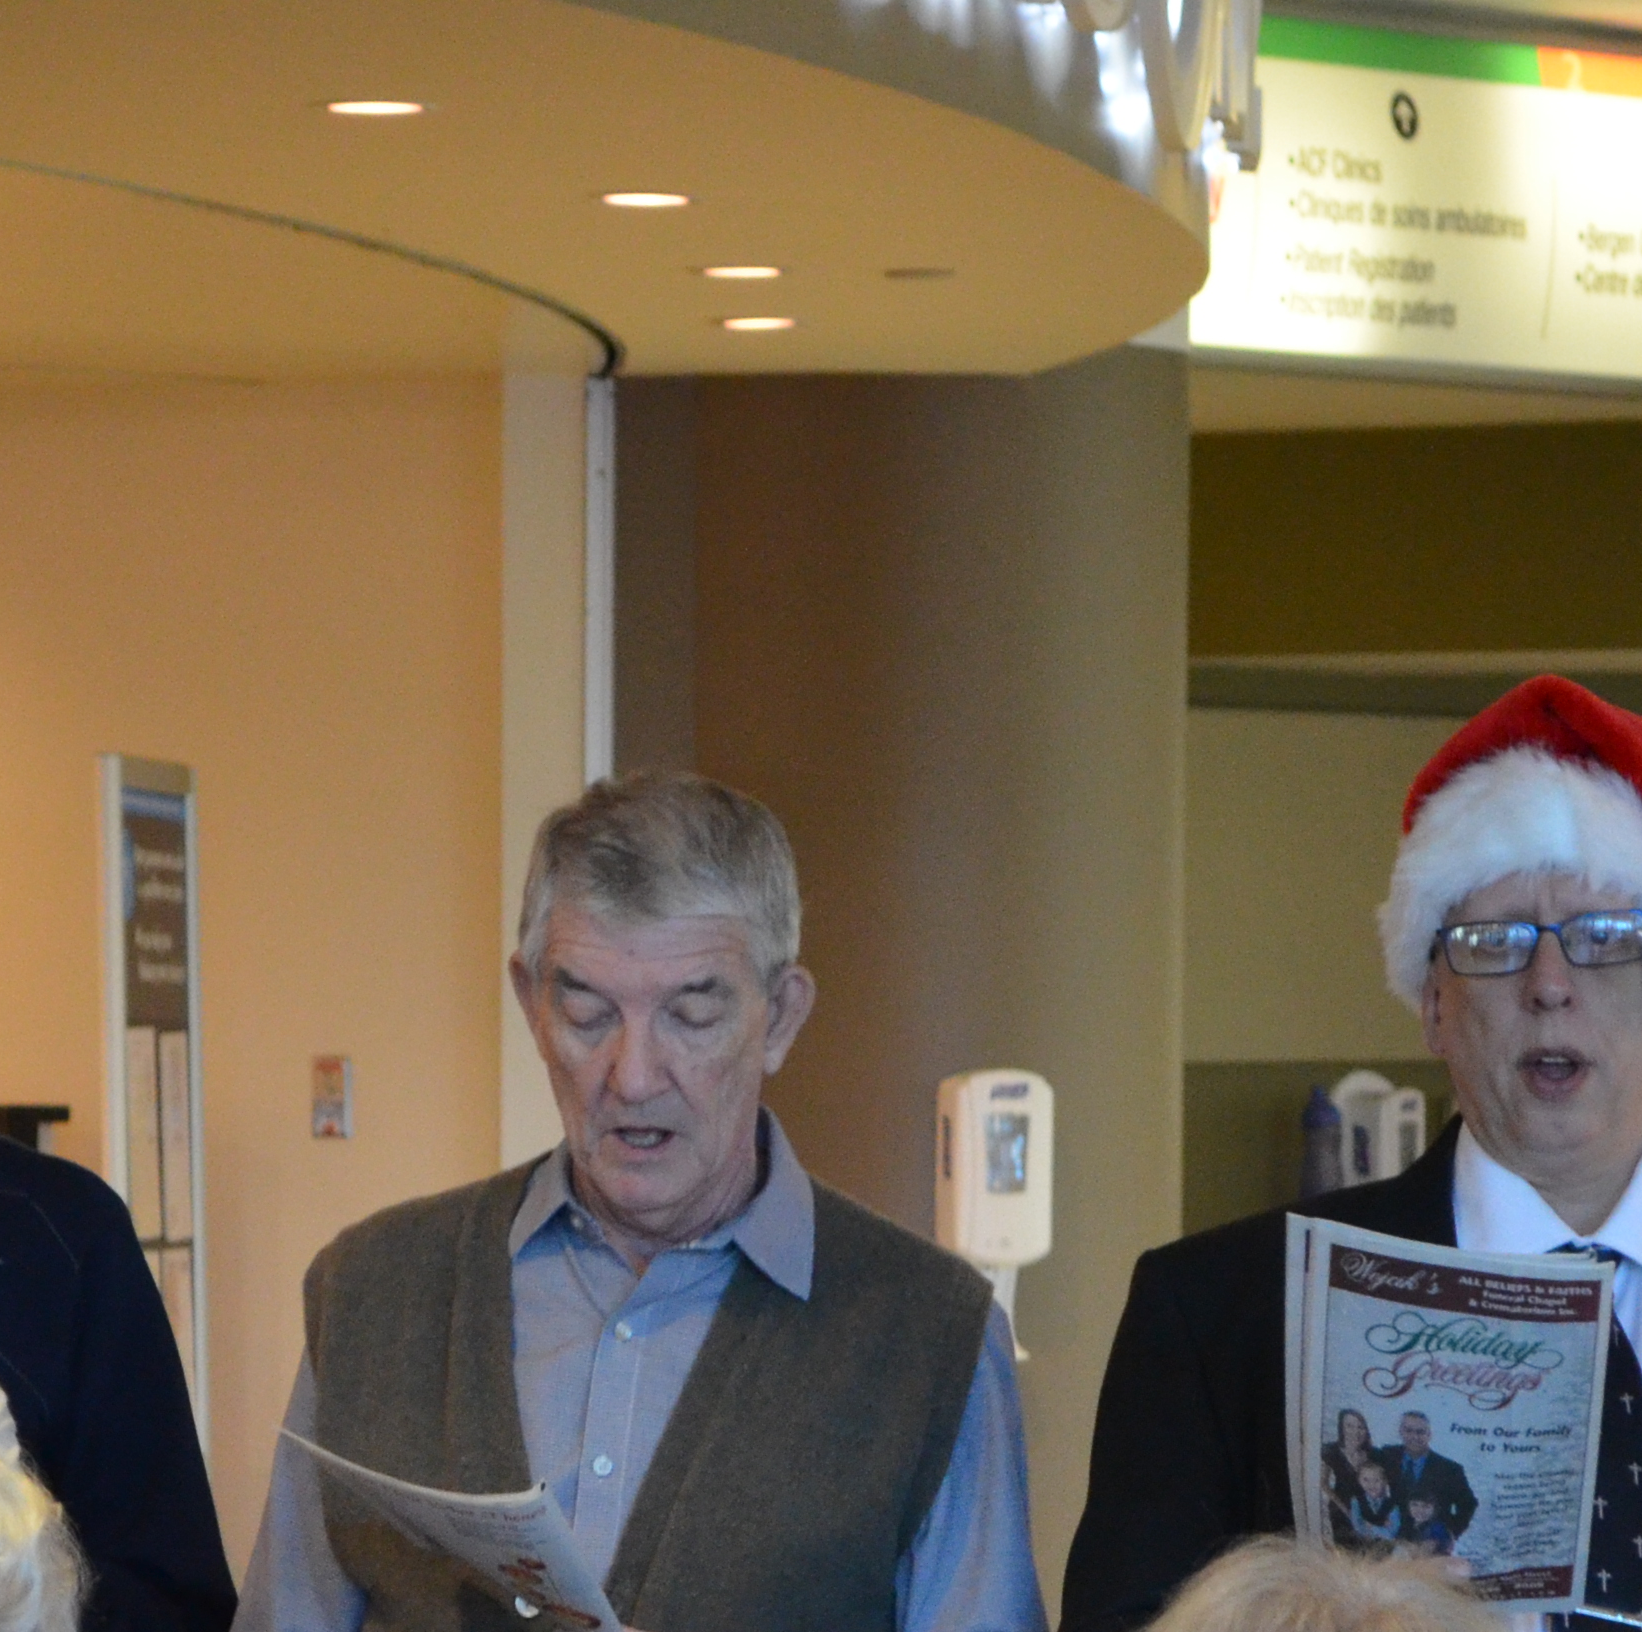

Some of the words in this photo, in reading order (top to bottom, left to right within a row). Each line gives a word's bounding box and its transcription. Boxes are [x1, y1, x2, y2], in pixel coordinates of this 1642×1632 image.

[1369, 198, 1387, 226] de
[1349, 247, 1436, 283] Registration
[1365, 1311, 1564, 1370] Holiday
[1362, 1350, 1552, 1412] Greetings
[1450, 1422, 1487, 1437] From
[1493, 1426, 1519, 1438] Our
[1480, 1442, 1496, 1453] to
